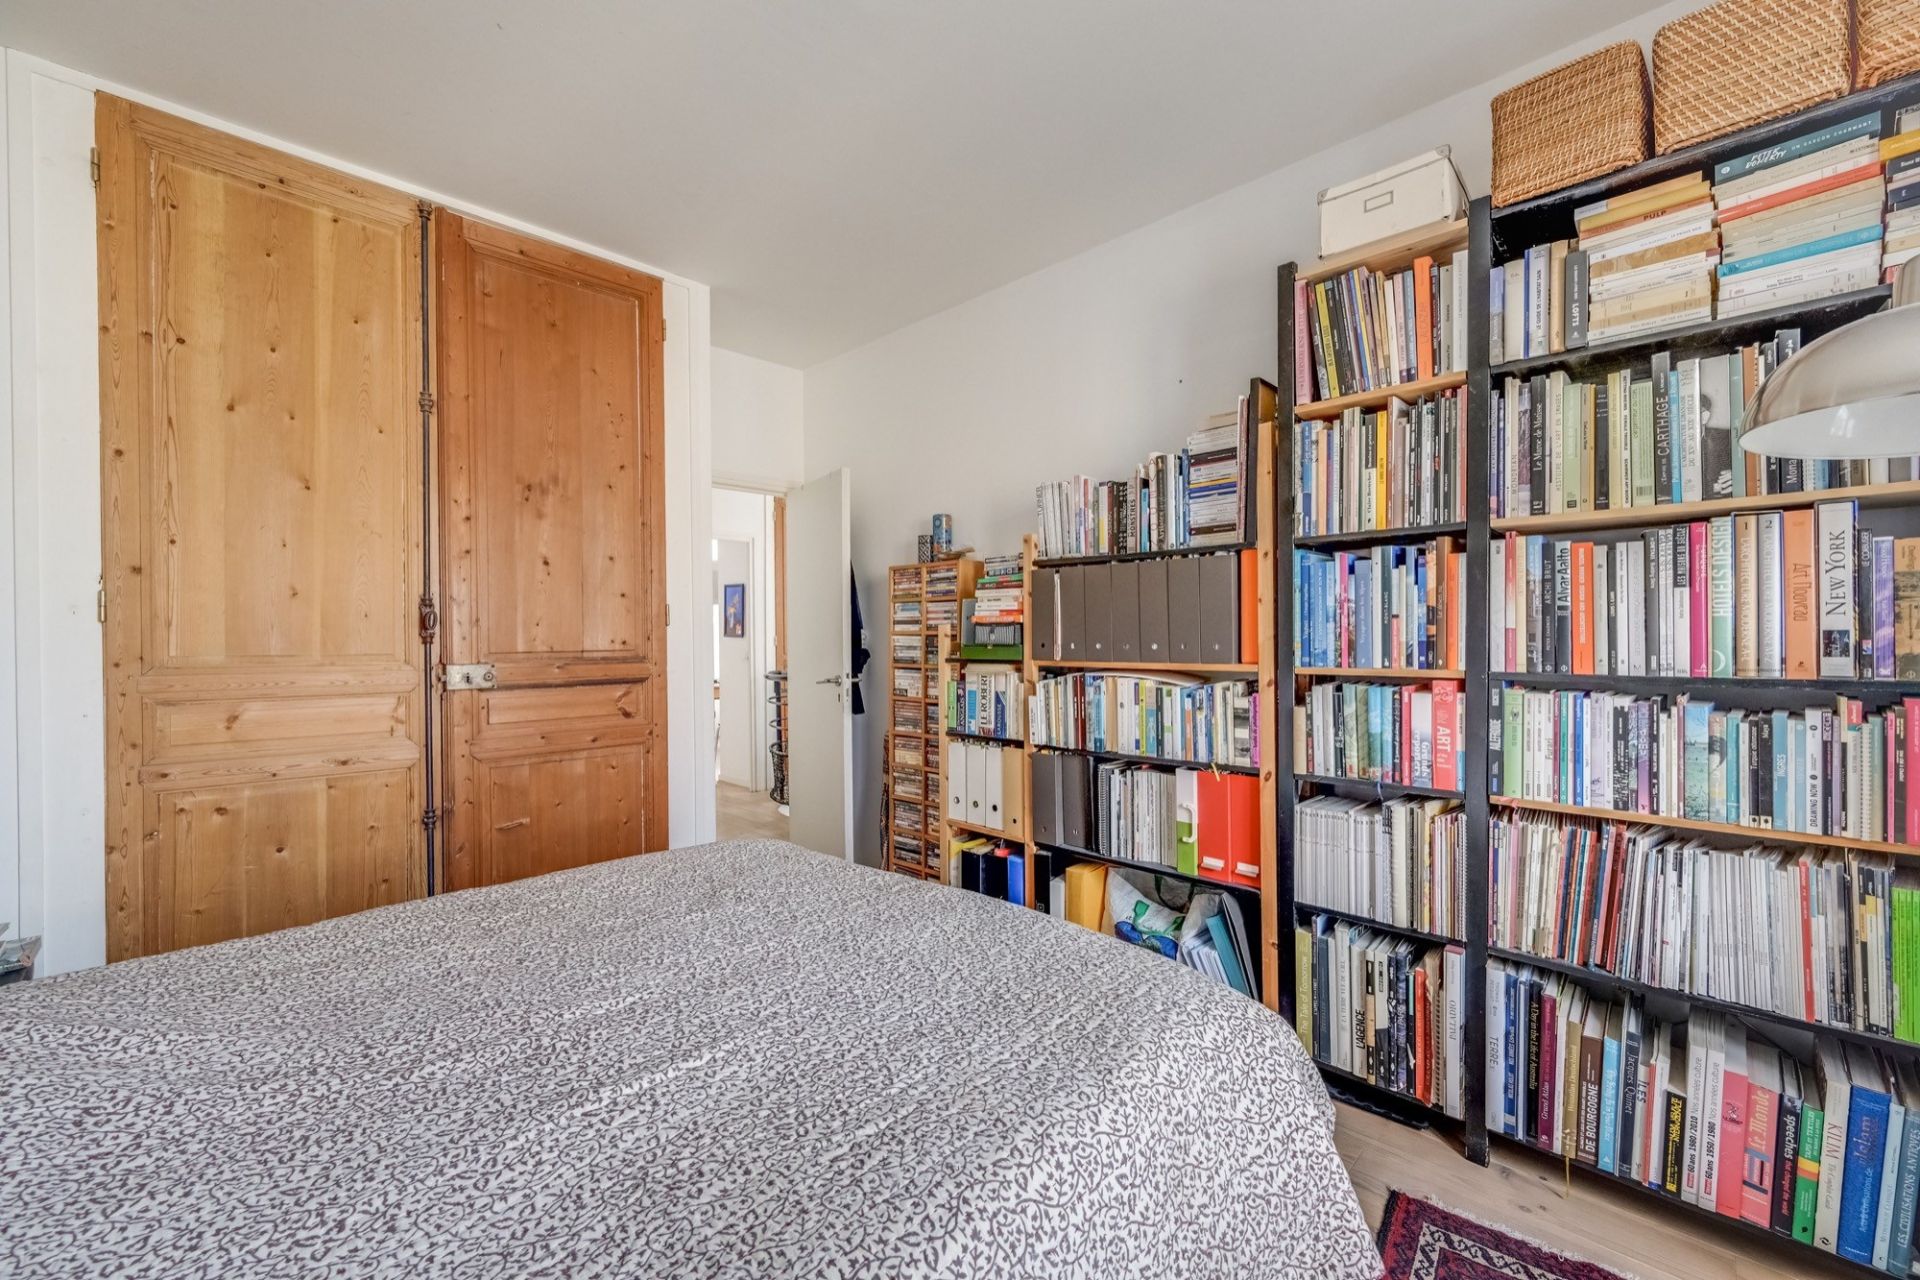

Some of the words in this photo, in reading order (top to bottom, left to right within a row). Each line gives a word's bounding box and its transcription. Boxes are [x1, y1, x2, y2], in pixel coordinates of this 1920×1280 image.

[1643, 210, 1667, 222] PULP
[1534, 402, 1543, 428] Matisse
[1656, 395, 1669, 456] CARTHAGE
[1533, 428, 1543, 438] de
[1533, 438, 1543, 460] Maroc
[1533, 459, 1542, 471] Le
[1764, 519, 1773, 529] 2
[1711, 516, 1732, 565] DESIGN
[1824, 530, 1846, 575] YORK
[1544, 559, 1552, 579] BRUT
[1793, 563, 1811, 578] Art
[1676, 576, 1686, 585] LES
[1544, 581, 1552, 604] ARCHI
[1711, 568, 1732, 617] HOTELS
[1792, 581, 1812, 622] Nouveau
[1825, 576, 1846, 616] NEW
[980, 714, 987, 725] LE
[1437, 725, 1450, 752] ART
[1776, 754, 1786, 777] INGRES
[1809, 783, 1818, 798] NOW
[1809, 799, 1818, 828] DRAWING
[1299, 955, 1308, 993] Tomorrow
[1300, 994, 1308, 1003] of
[1300, 1003, 1308, 1018] Tale
[1448, 1000, 1456, 1041] PALLADIO
[1529, 1008, 1538, 1022] Day
[1300, 1019, 1308, 1034] The
[1355, 1009, 1365, 1049] L'AGENCE
[1530, 1029, 1538, 1040] the
[1530, 1040, 1538, 1052] Life
[1529, 1061, 1538, 1090] Australia
[1568, 1046, 1577, 1084] Deutschland
[1625, 1053, 1639, 1083] Jacques
[1693, 1057, 1702, 1078] culture
[1710, 1062, 1720, 1084] culture
[1624, 1086, 1636, 1114] Quinet
[1691, 1079, 1701, 1101] années
[1709, 1085, 1718, 1107] années
[1586, 1083, 1598, 1139] BOURGOGNE
[1690, 1101, 1699, 1115] Nos
[1708, 1107, 1717, 1120] Nos
[1750, 1091, 1769, 1136] Monde
[1688, 1116, 1698, 1152] 1980/2010
[1706, 1121, 1716, 1159] 1950/1980
[1750, 1136, 1766, 1151] Le
[1784, 1115, 1798, 1159] speeches
[1825, 1123, 1842, 1160] KILIM
[1586, 1139, 1596, 1153] DE
[1899, 1173, 1916, 1231] CIVILISATIONS
[1897, 1233, 1908, 1248] LES
